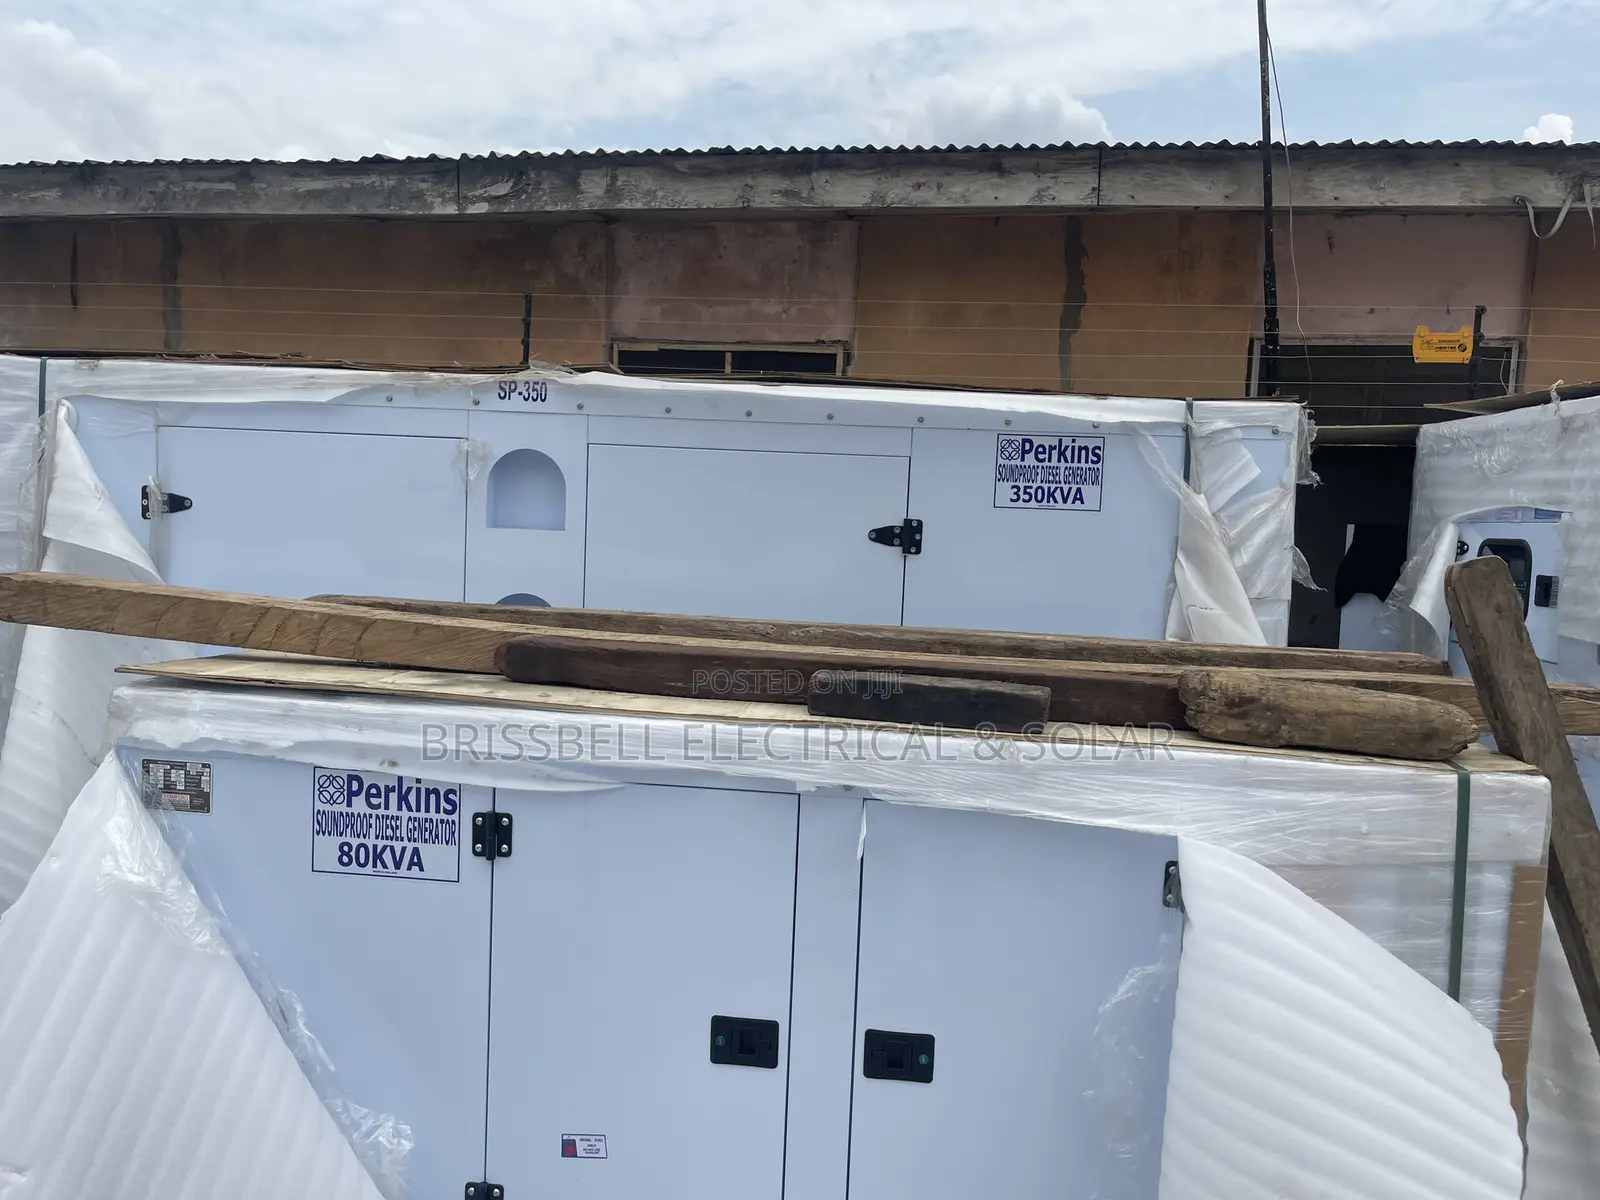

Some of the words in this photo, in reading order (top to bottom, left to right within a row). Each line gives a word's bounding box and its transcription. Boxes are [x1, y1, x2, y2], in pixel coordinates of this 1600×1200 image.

[498, 380, 547, 402] SP-350
[1020, 438, 1101, 465] Perkins
[998, 463, 1039, 484] SOUNDPROOF
[1040, 465, 1062, 485] DIESEL
[1063, 466, 1100, 487] GENERATOR
[1010, 484, 1084, 505] 350KVA
[346, 773, 458, 815] Perkins
[315, 809, 373, 839] SOUNDPROOF
[374, 813, 405, 842] DIESEL
[406, 816, 457, 846] GENERATOR
[338, 841, 425, 872] 80KVA
